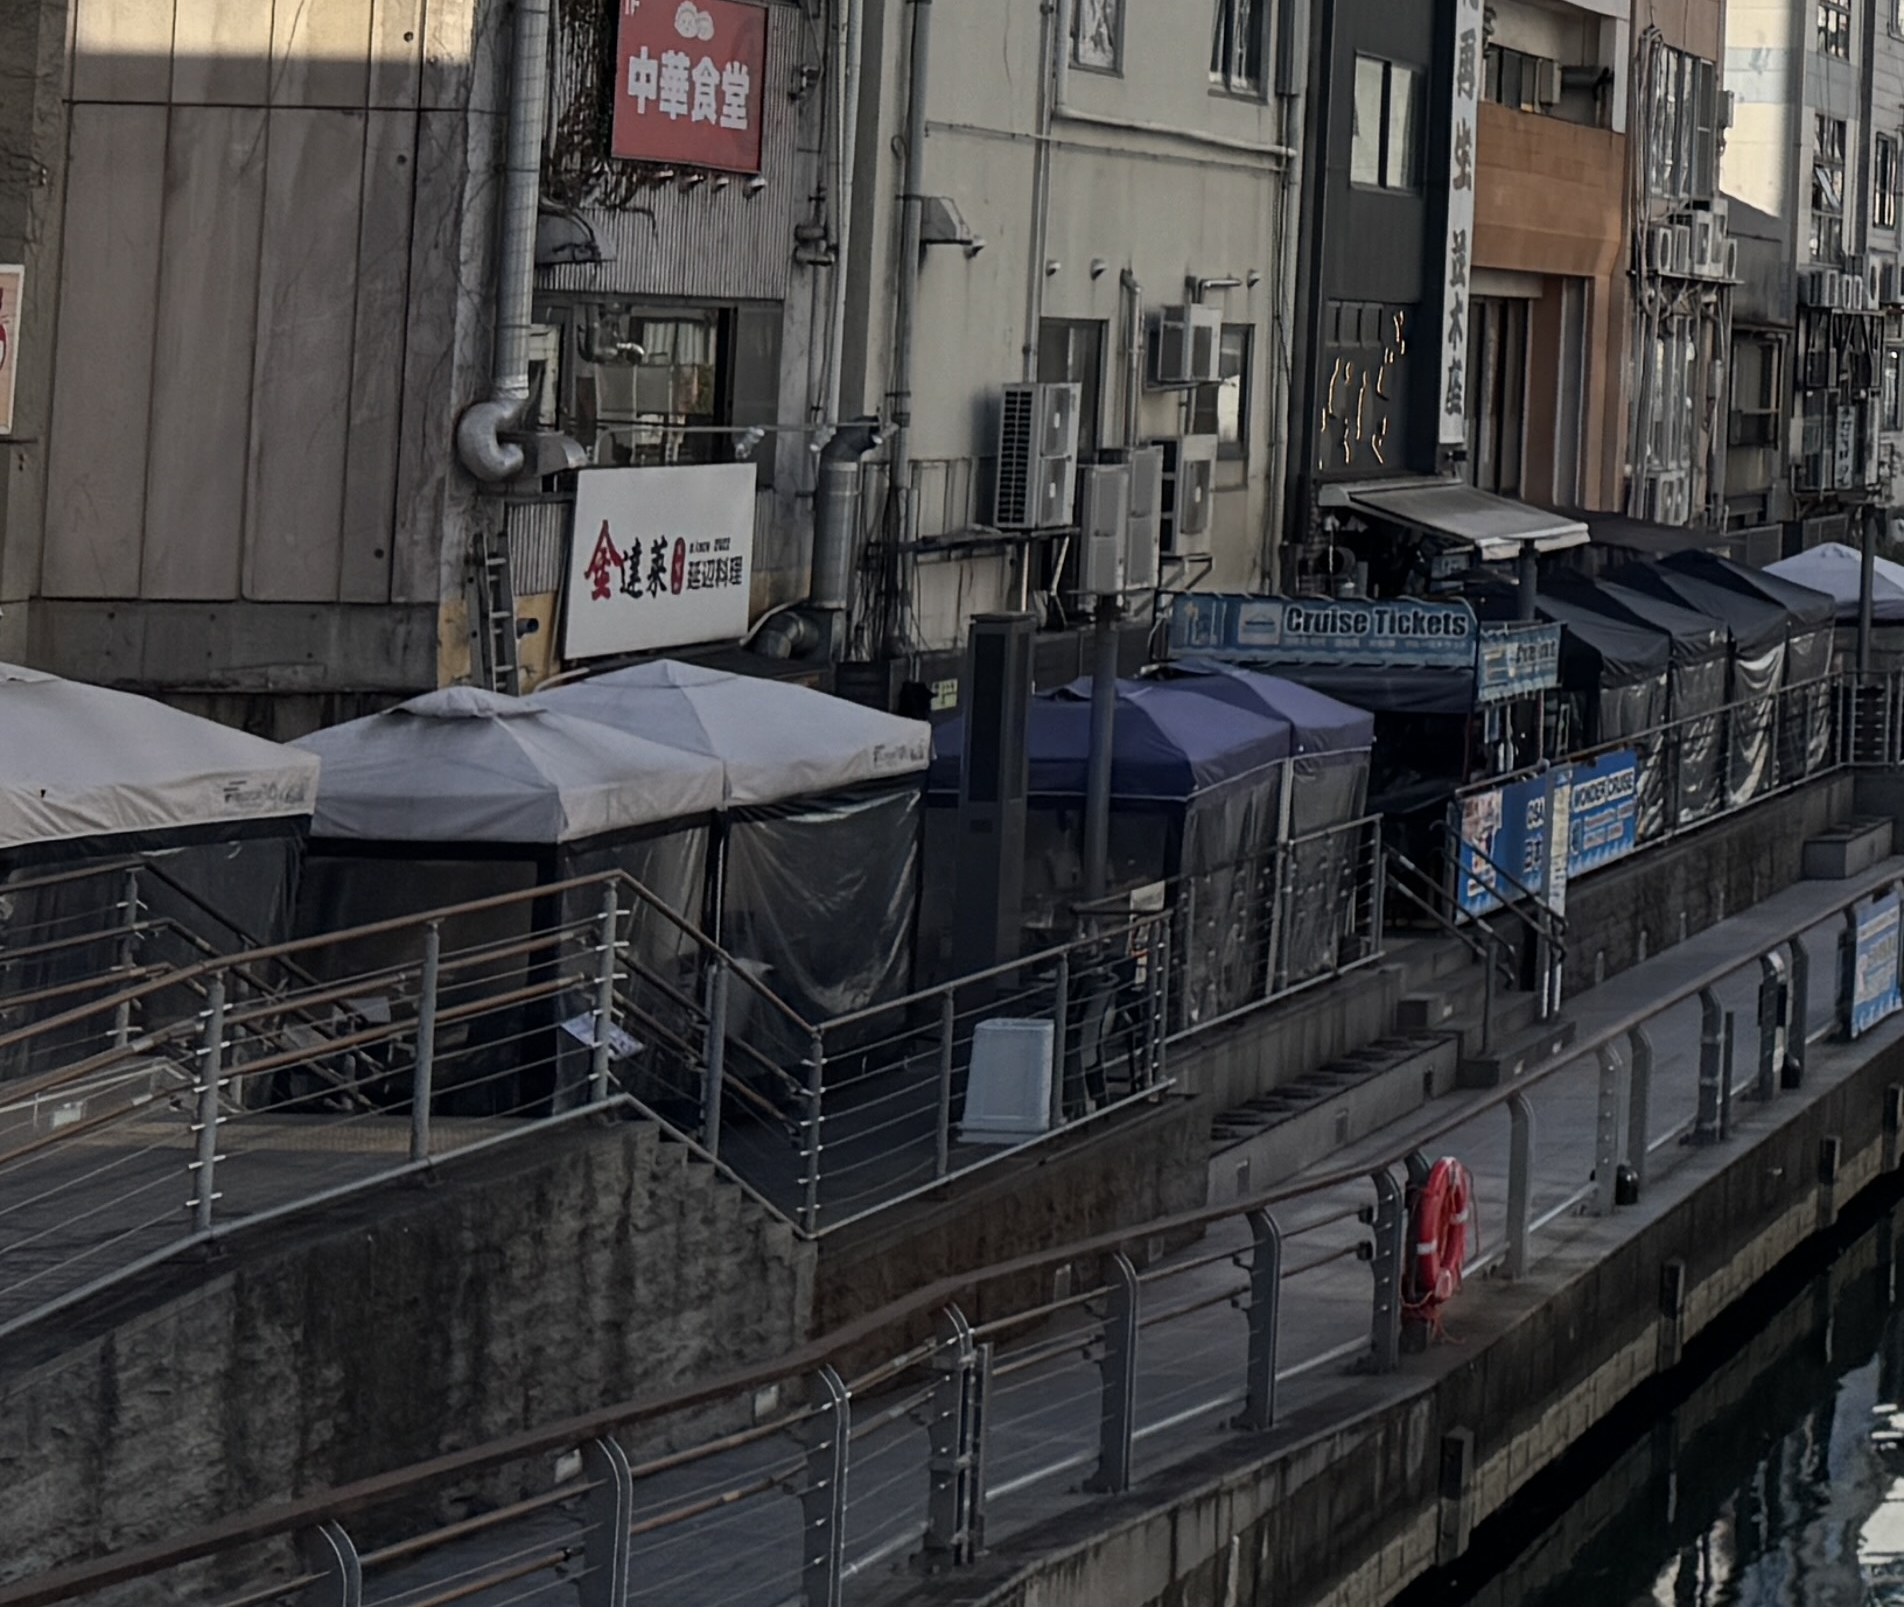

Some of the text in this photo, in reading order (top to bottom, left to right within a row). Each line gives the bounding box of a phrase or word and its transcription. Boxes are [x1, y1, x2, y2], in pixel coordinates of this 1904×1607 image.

[627, 45, 751, 131] 中華食堂
[1286, 607, 1467, 637] Cruise Tickets
